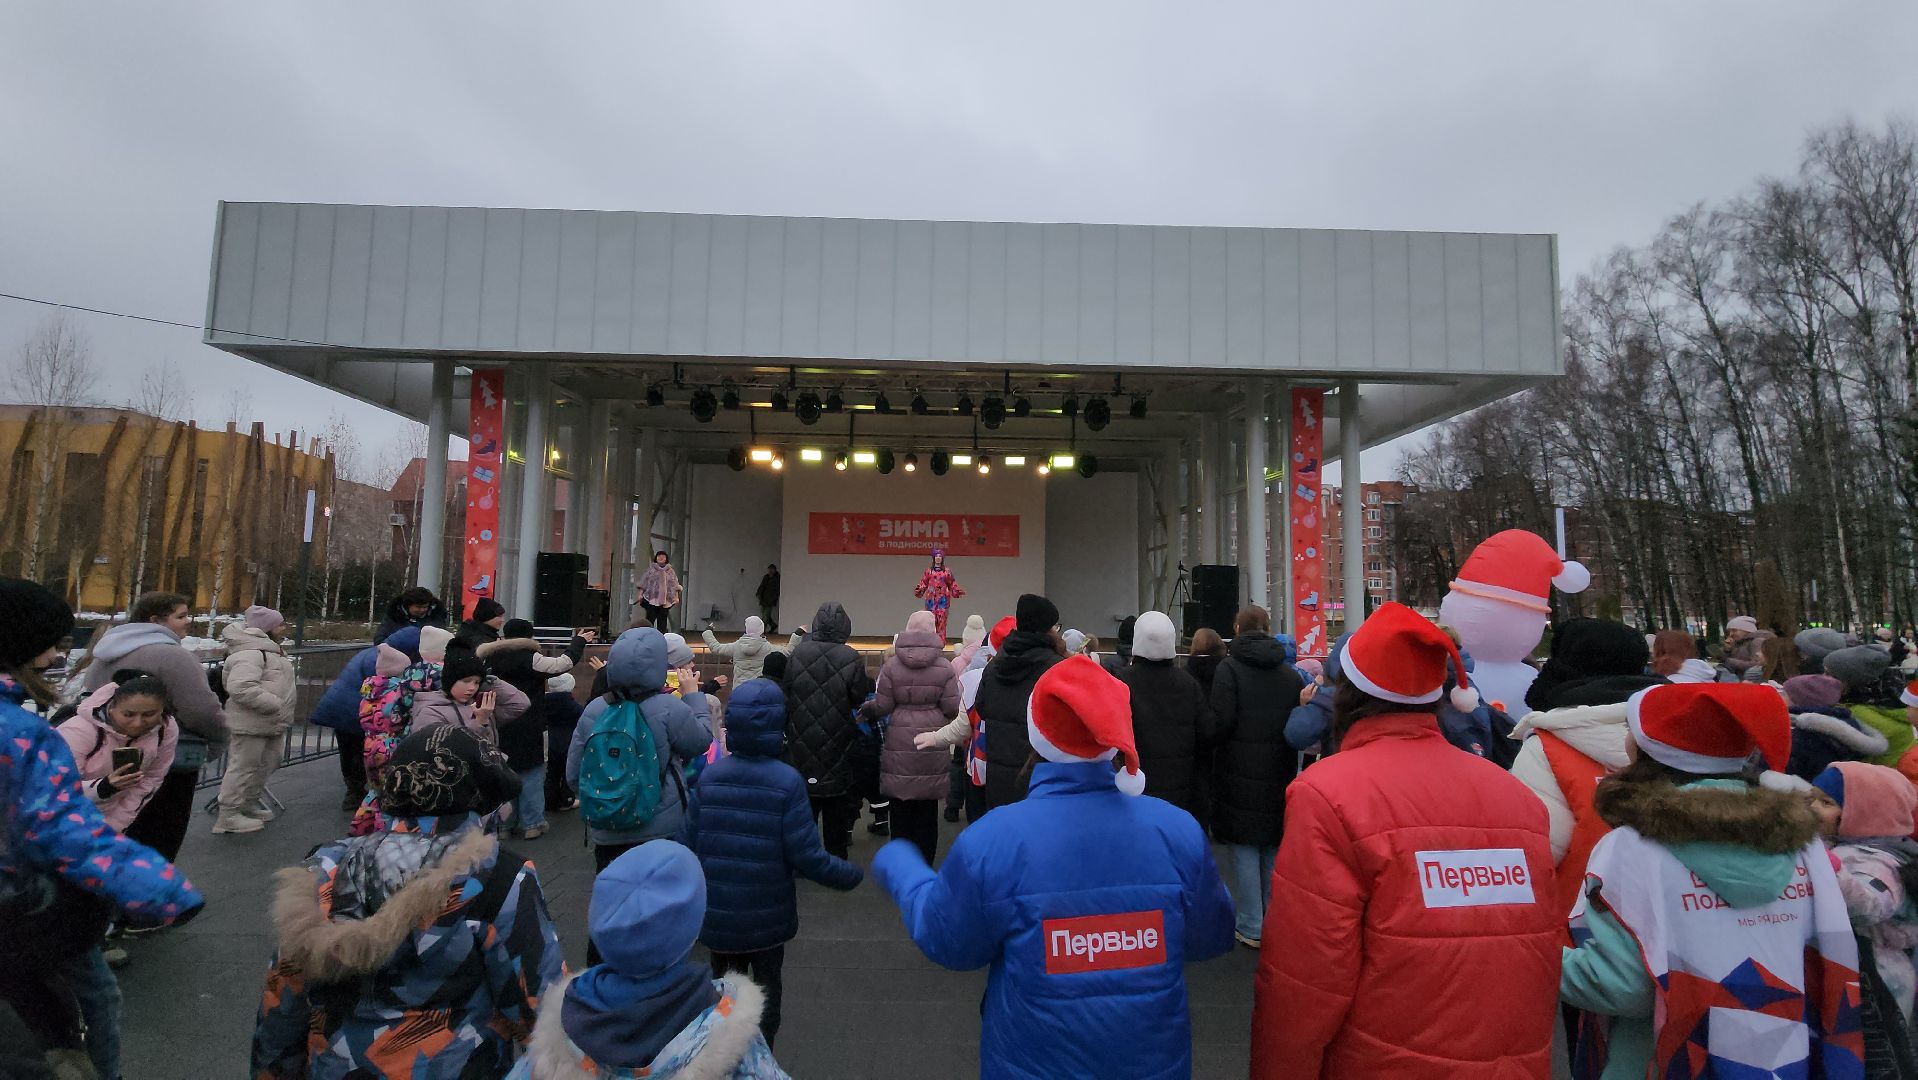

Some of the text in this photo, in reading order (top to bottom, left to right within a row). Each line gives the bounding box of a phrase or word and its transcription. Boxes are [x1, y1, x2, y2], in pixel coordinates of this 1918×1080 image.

[879, 519, 950, 538] ЗИМА
[1423, 861, 1526, 896] Первые
[1051, 927, 1158, 963] Первые
